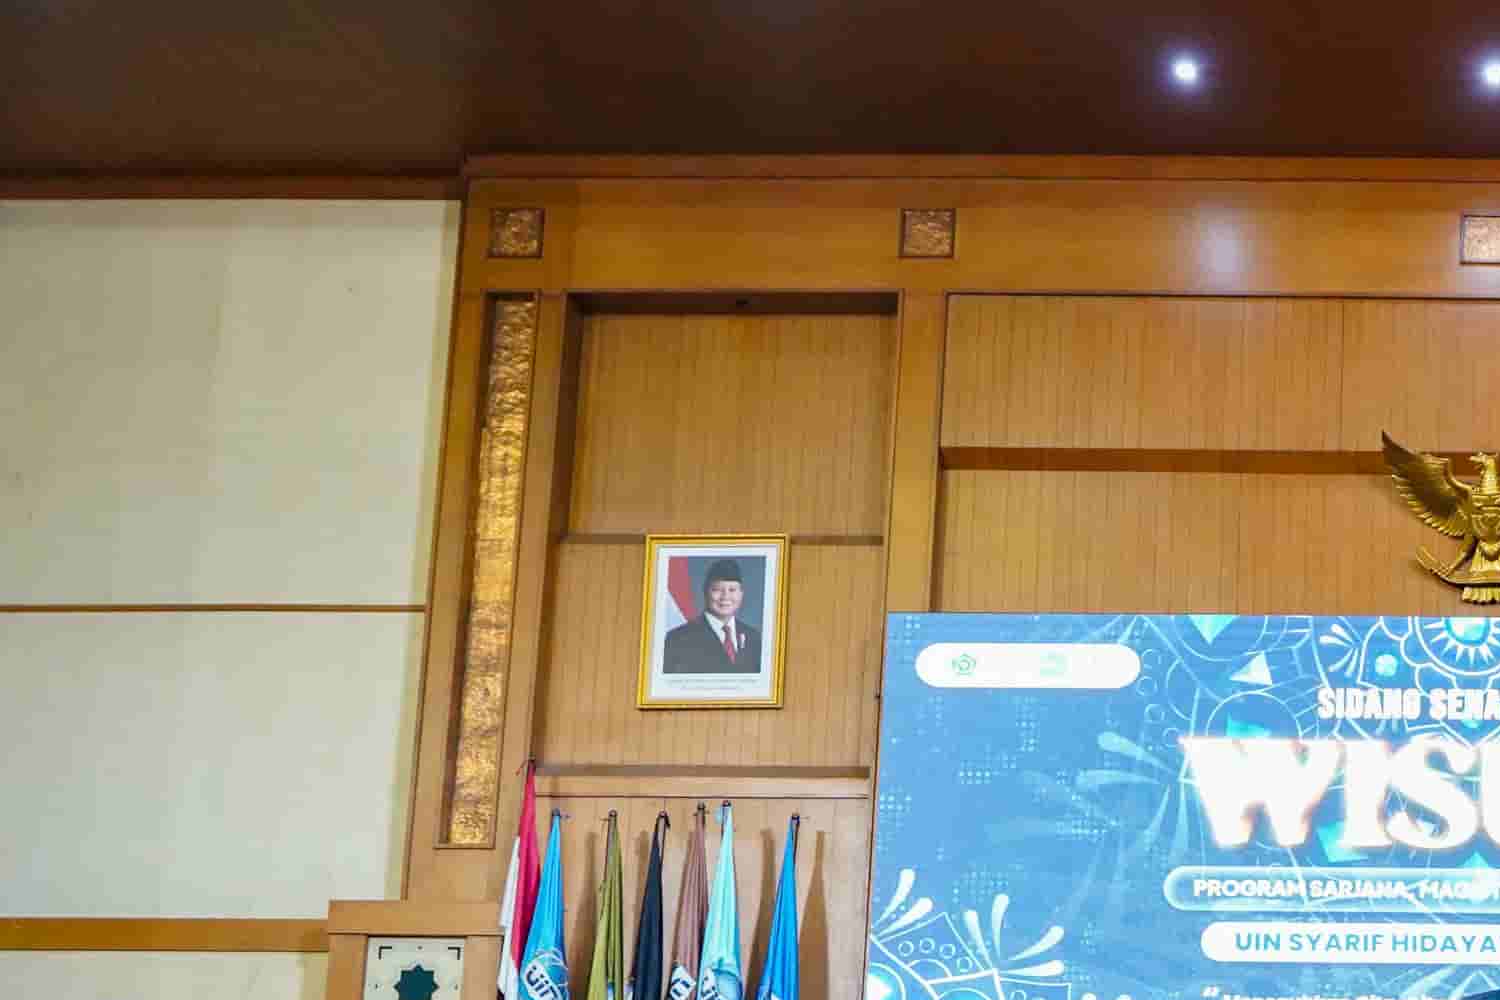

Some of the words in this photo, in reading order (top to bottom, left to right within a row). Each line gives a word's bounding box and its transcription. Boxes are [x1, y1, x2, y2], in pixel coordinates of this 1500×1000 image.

[1193, 879, 1306, 897] PROGRAM
[1235, 933, 1281, 951] UIN
[1289, 933, 1384, 952] SYARIF
